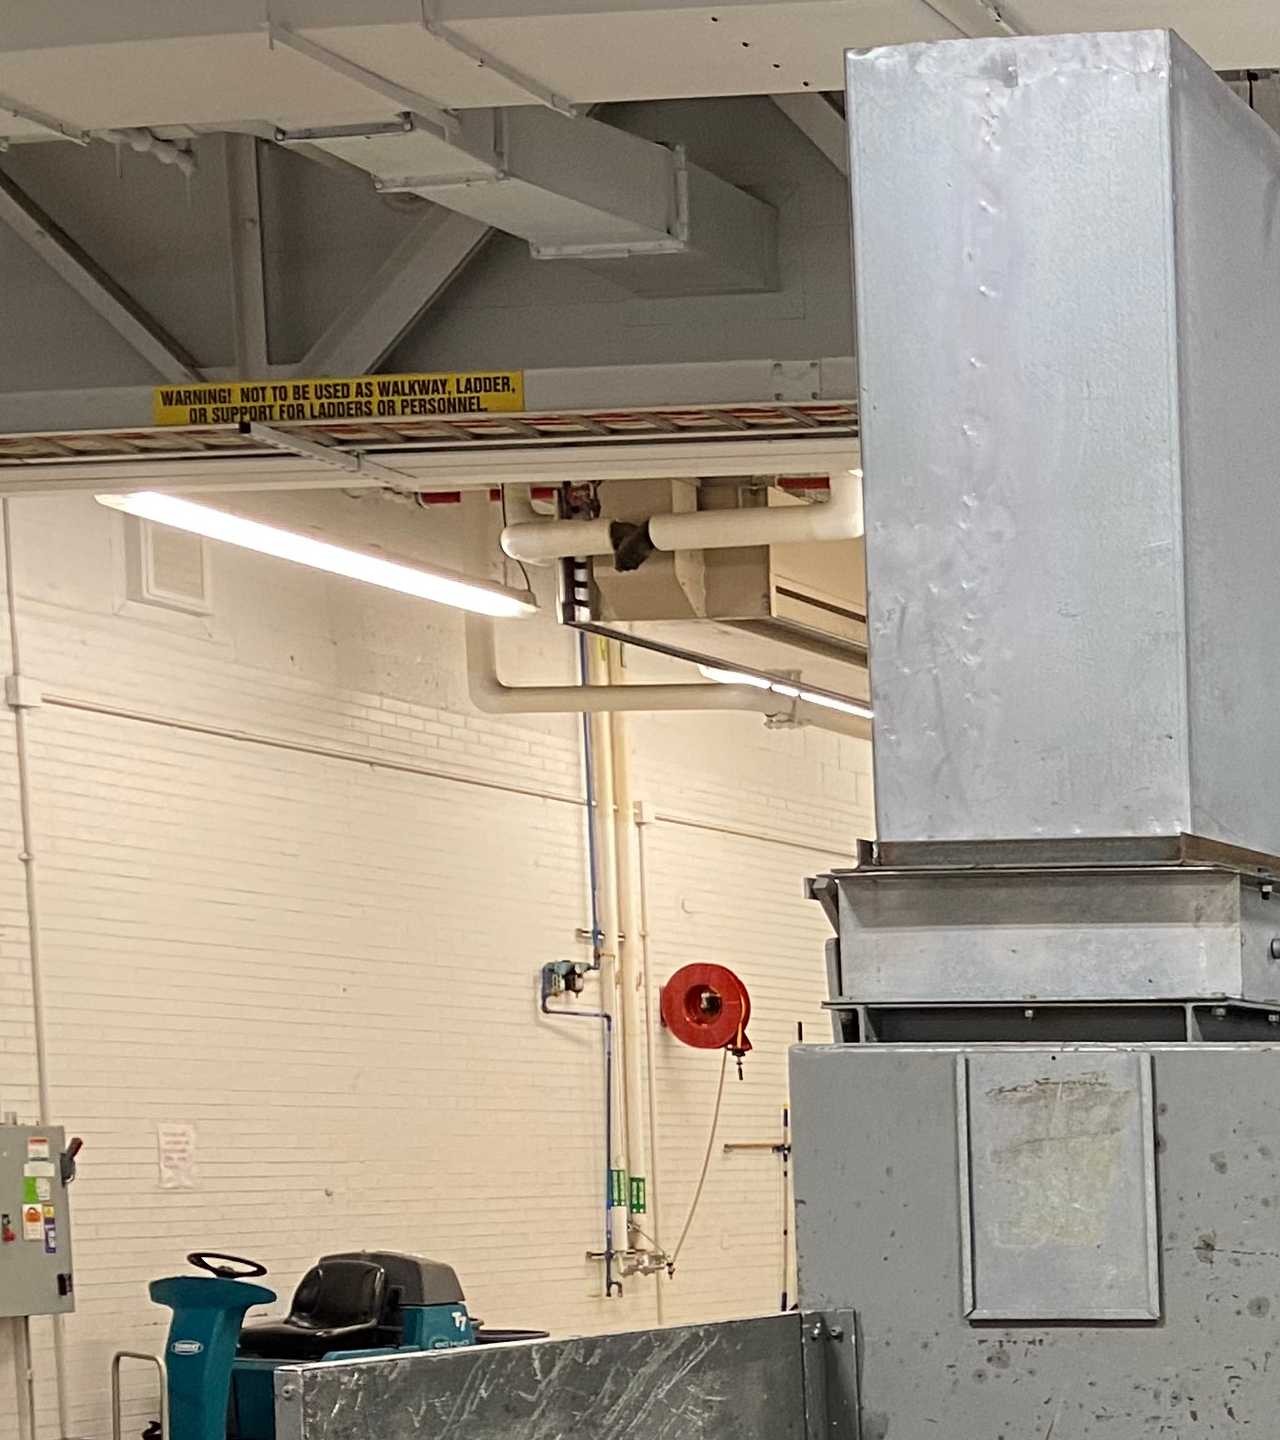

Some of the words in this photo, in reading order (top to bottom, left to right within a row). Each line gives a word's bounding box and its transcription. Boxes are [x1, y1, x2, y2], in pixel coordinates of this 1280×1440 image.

[160, 387, 232, 406] WARNING!
[240, 386, 267, 403] NOT
[271, 385, 288, 402] TO
[292, 383, 310, 401] BE
[314, 382, 350, 400] USED
[355, 381, 373, 399] AS
[377, 378, 452, 398] WALKWAY,
[189, 407, 208, 424] OR
[212, 405, 275, 424] SUPPORT
[279, 403, 305, 421] FOR
[310, 400, 373, 419] LADDERS
[377, 399, 396, 416] OR
[401, 396, 488, 415] PERSONNEL.
